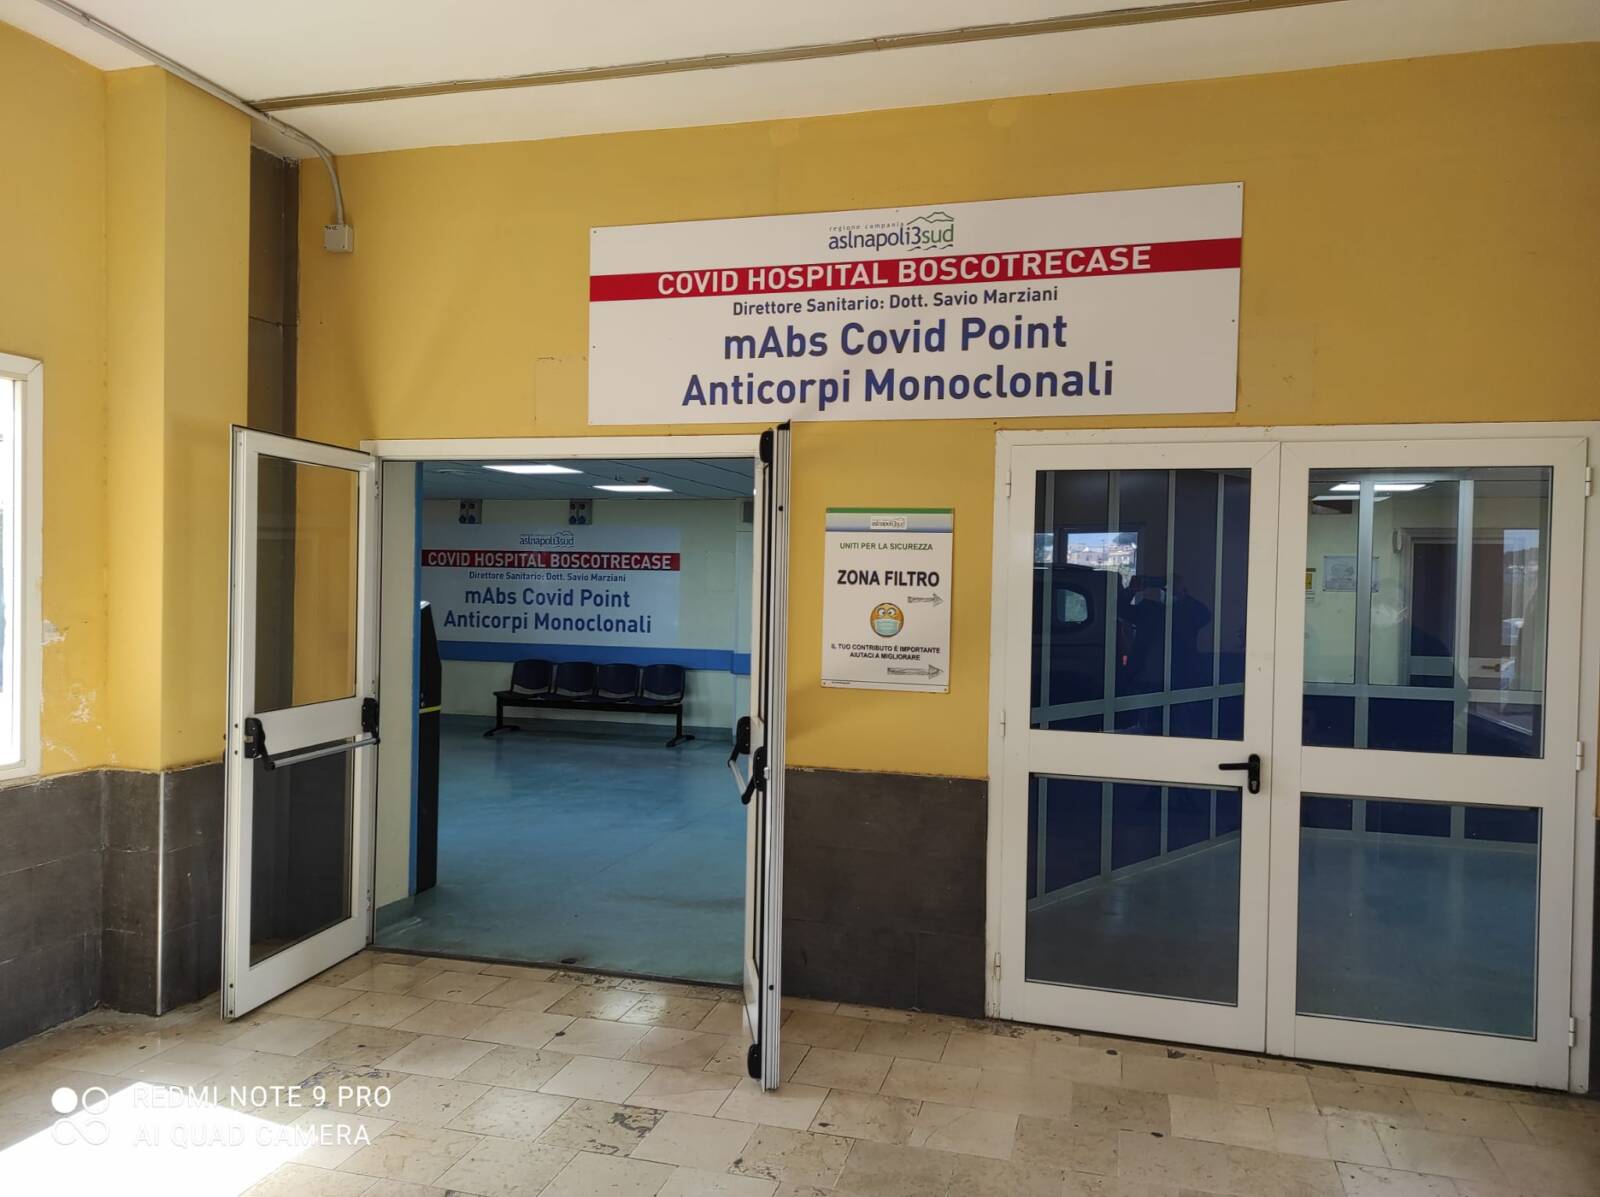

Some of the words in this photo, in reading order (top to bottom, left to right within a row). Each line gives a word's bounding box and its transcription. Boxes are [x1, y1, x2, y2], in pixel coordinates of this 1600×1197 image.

[828, 223, 955, 252] aslnapoli3sud
[657, 269, 740, 296] COVID
[747, 261, 889, 292] HOSPITAL
[898, 245, 1152, 286] BOSCOTRECASE
[732, 298, 802, 316] Direttore
[806, 294, 885, 314] Sanitario:
[889, 292, 928, 310] Dott.
[933, 289, 978, 308] Savio
[983, 285, 1058, 305] Marziani
[724, 324, 829, 360] mAbs
[840, 317, 946, 355] Covid
[961, 313, 1068, 351] Point
[682, 368, 851, 411] Anticorpi
[864, 360, 1114, 402] Monoclonali
[840, 542, 860, 550] UNITI
[890, 543, 933, 551] SICUREZZA
[428, 552, 470, 566] COVID
[474, 553, 546, 568] HOSPITAL
[550, 553, 672, 570] BOSCOTRECASE
[469, 571, 504, 580] Direttore
[546, 573, 564, 581] Dott.
[567, 573, 588, 582] Savio
[591, 573, 626, 582] Marziani
[837, 569, 880, 586] ZONA
[885, 571, 940, 587] FILTRO
[465, 587, 516, 605] mAbs
[522, 588, 574, 606] Covid
[580, 589, 631, 607] Point
[443, 610, 528, 634] Anticorpi
[534, 612, 651, 633] Monoclonali
[852, 644, 893, 652] CONTRIBUTO
